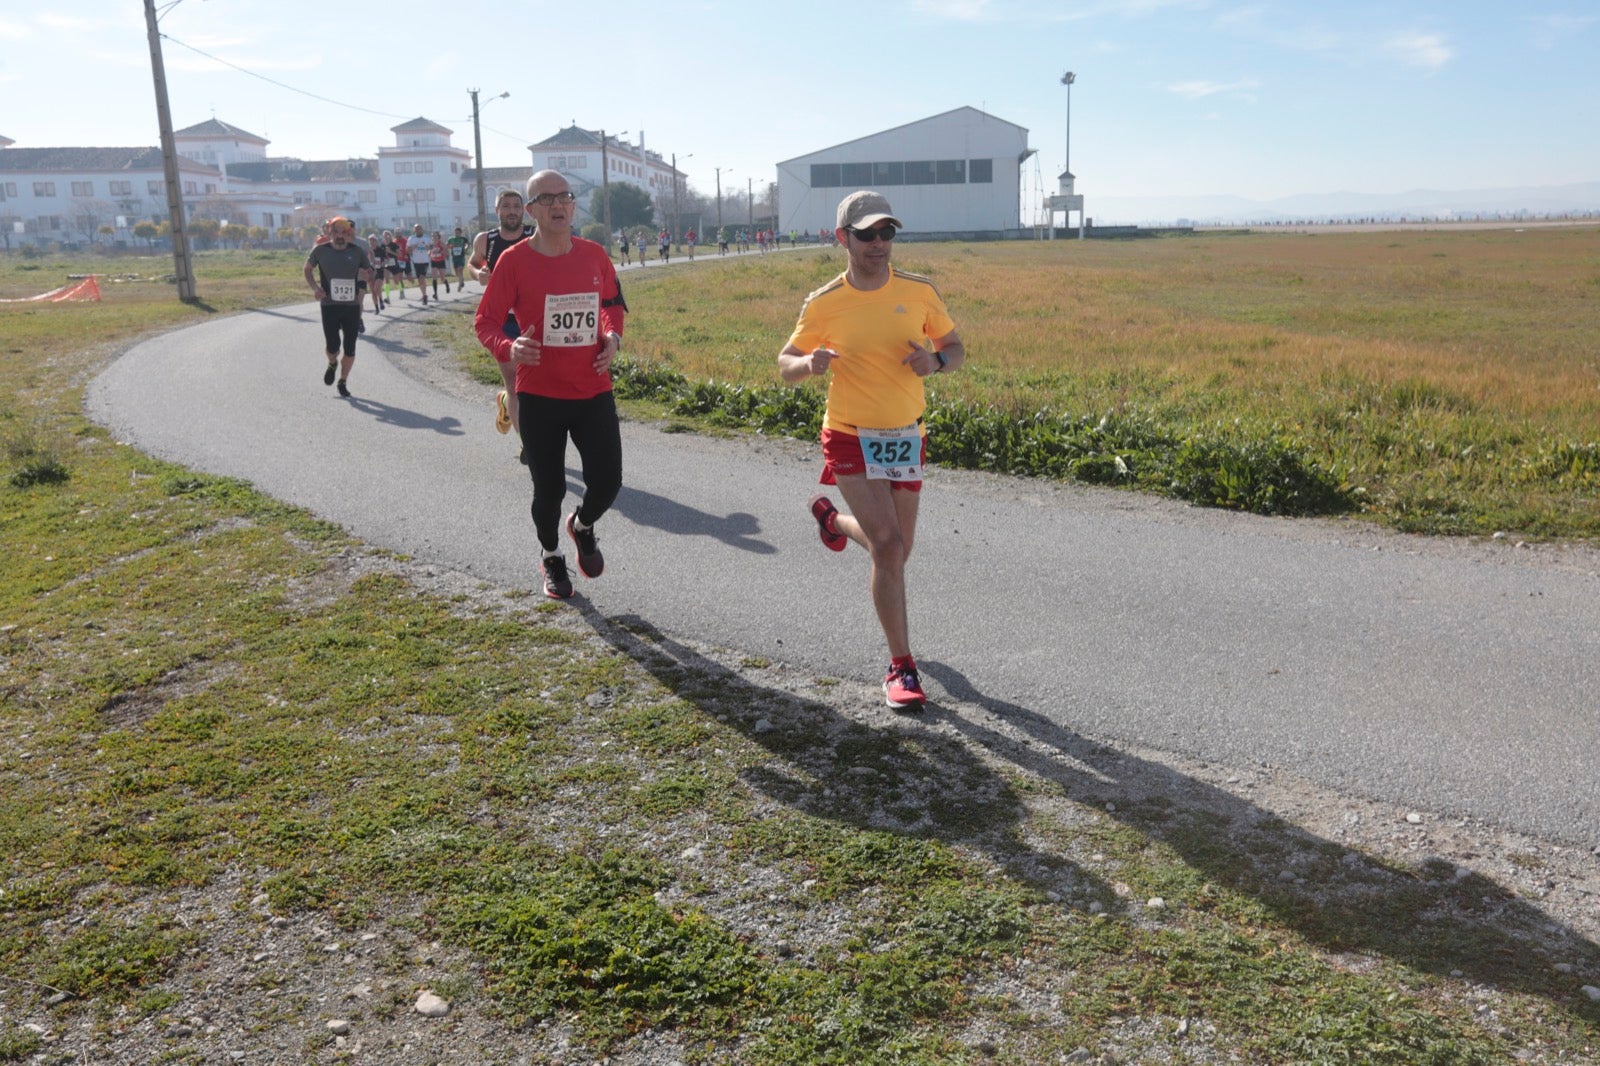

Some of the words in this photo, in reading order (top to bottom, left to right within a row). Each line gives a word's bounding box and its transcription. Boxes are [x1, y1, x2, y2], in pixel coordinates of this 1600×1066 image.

[334, 286, 353, 294] 3121
[550, 311, 595, 329] 3076
[868, 440, 912, 463] 252
